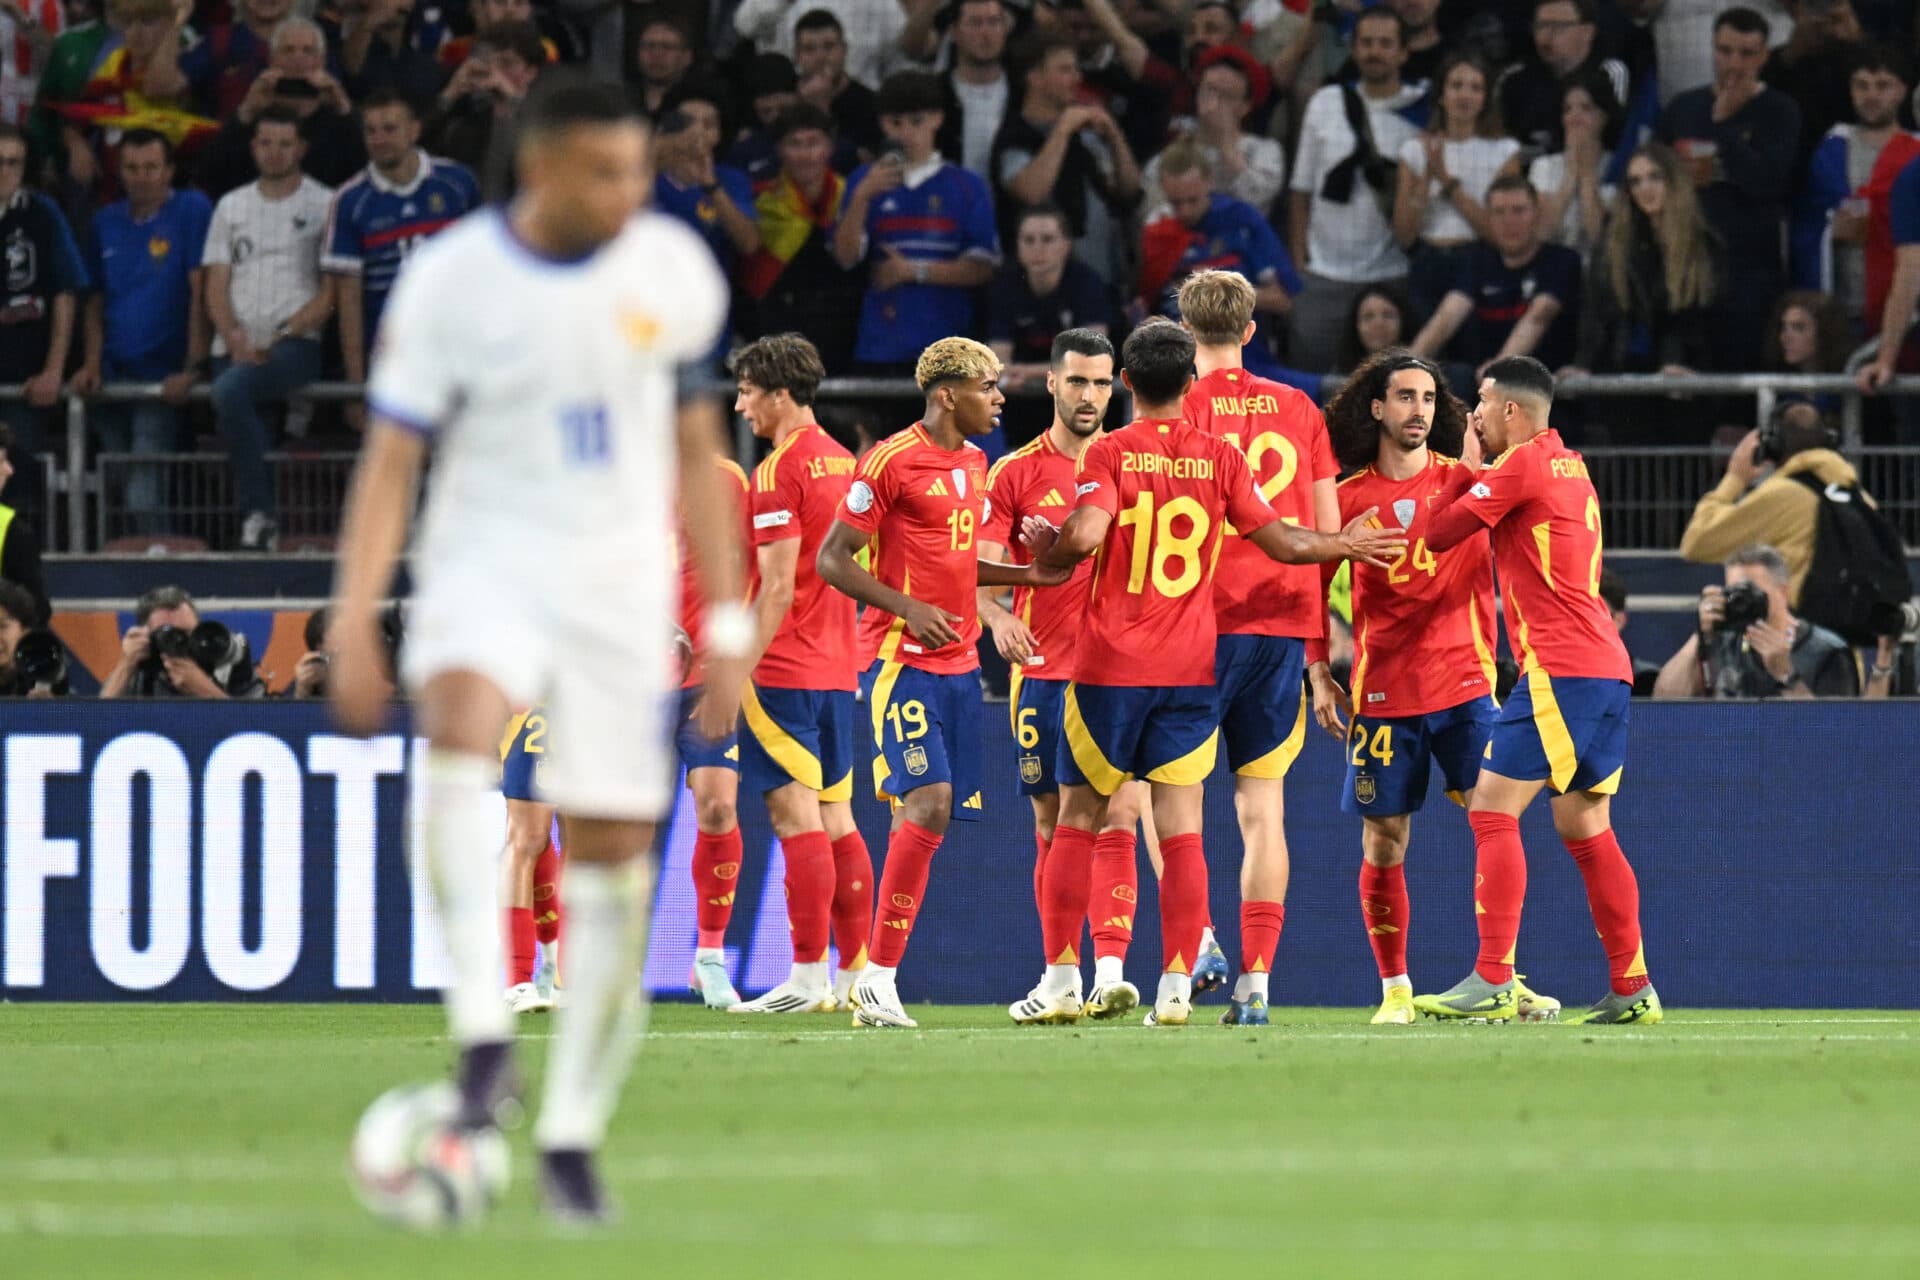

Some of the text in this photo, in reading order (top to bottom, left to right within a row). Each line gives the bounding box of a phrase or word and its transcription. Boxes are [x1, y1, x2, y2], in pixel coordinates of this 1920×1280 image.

[1211, 395, 1278, 416] HUIJSEN
[1122, 452, 1212, 480] ZUBIMENDI
[946, 508, 975, 551] 19
[1118, 491, 1210, 598] 18
[1382, 537, 1437, 584] 24
[885, 699, 928, 742] 19
[1017, 707, 1038, 748] 6
[1351, 724, 1394, 767] 24
[4, 732, 440, 990] FOOT
